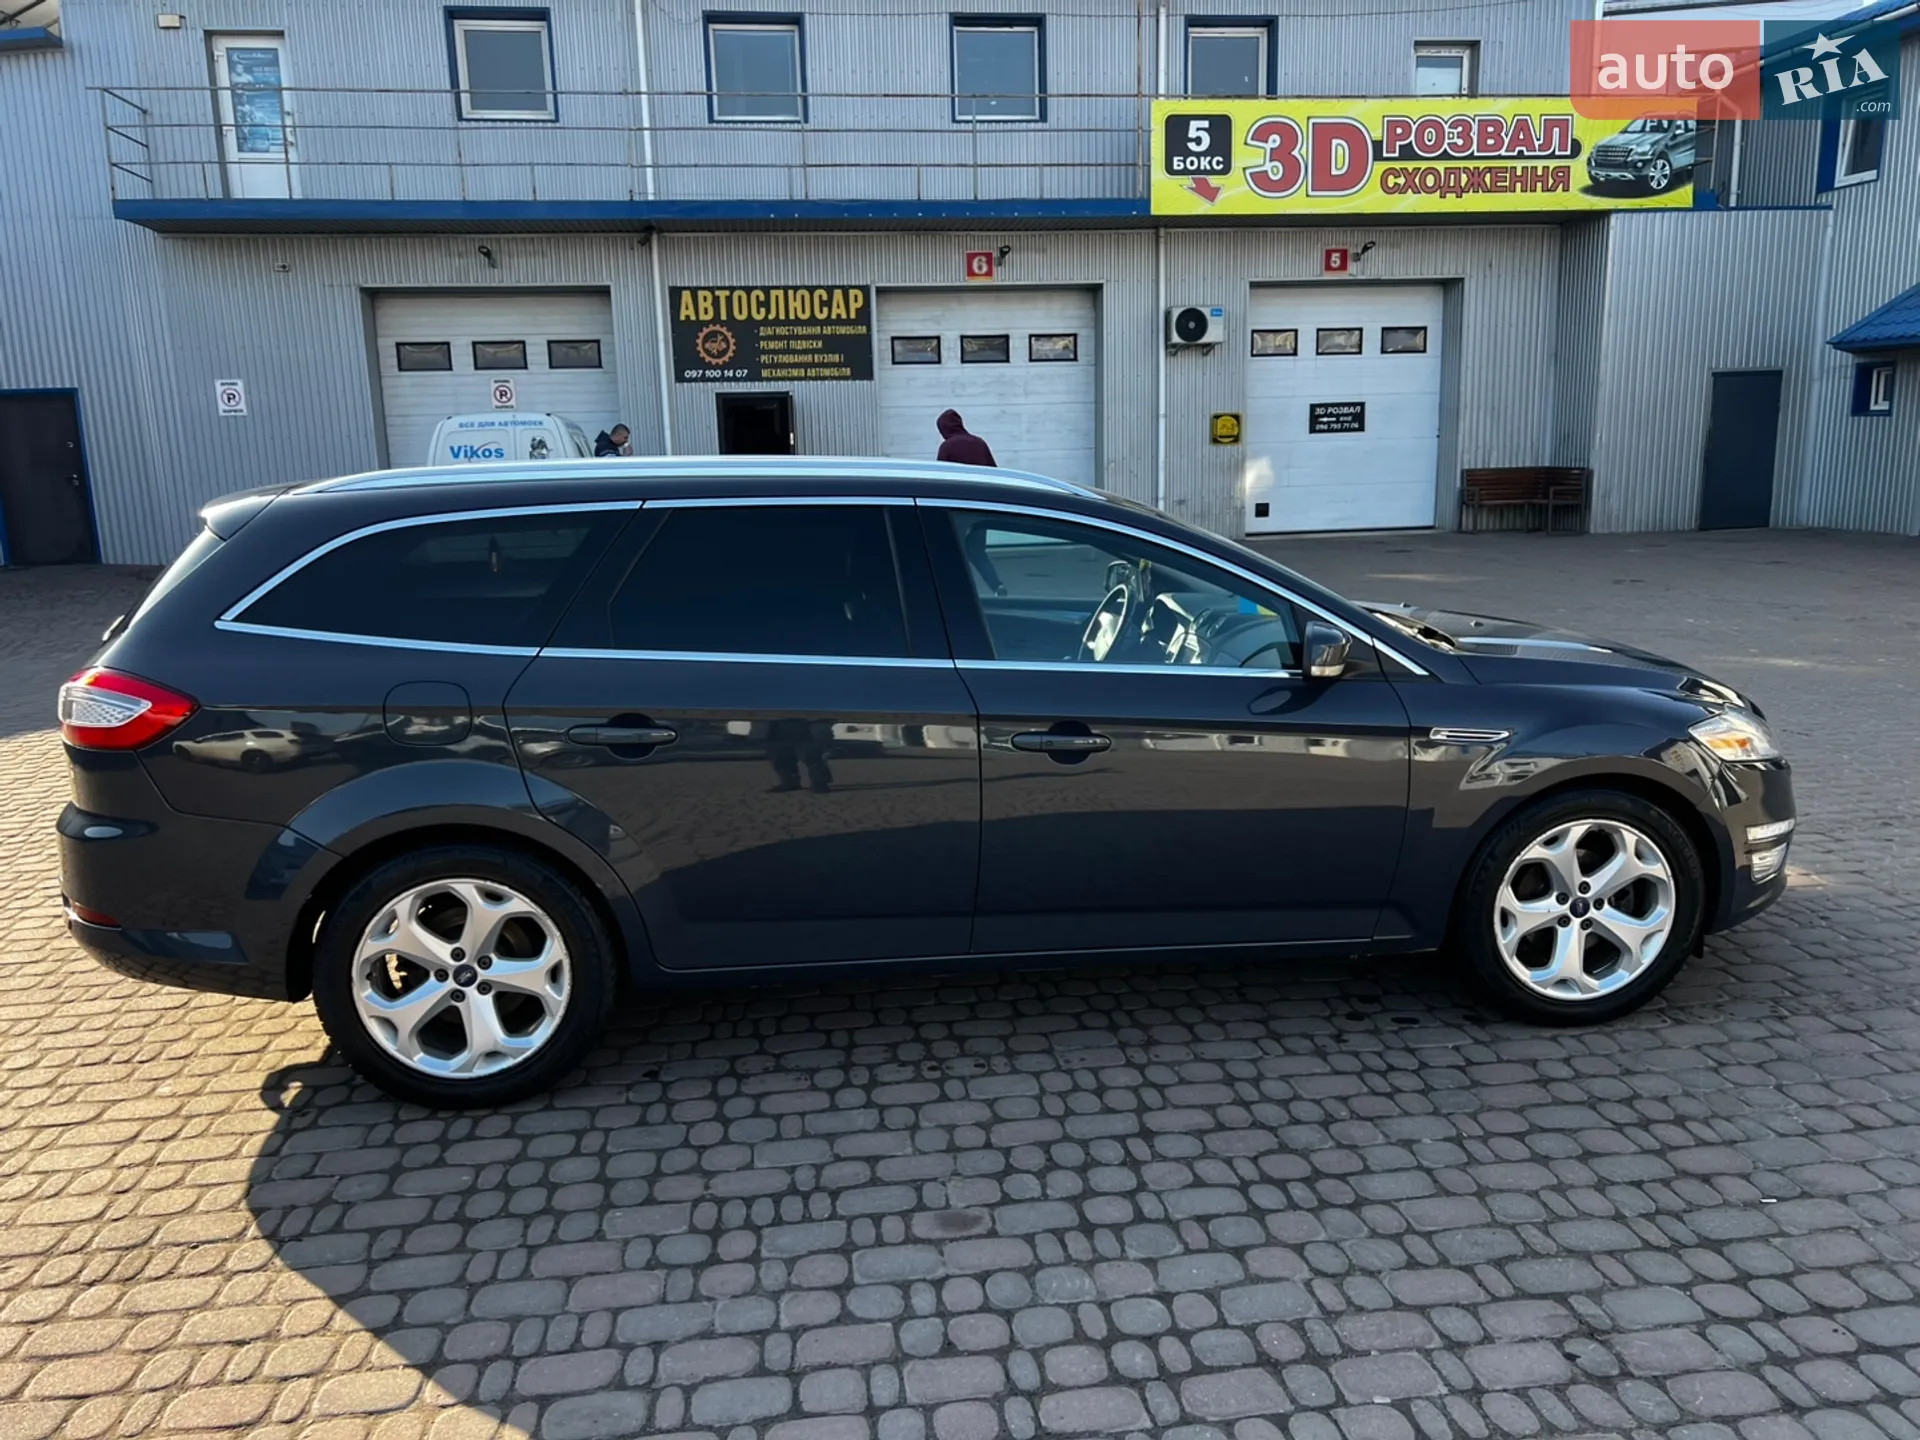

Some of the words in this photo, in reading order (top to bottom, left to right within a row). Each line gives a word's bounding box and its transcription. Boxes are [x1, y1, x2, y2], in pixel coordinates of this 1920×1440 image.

[1186, 120, 1211, 153] 5
[1382, 114, 1574, 158] РОЗВАЛ
[1172, 156, 1225, 171] БОКС
[1243, 115, 1374, 199] 3D
[1380, 165, 1570, 198] СХОДЖЕННЯ
[972, 254, 989, 275] 6
[1330, 252, 1341, 268] 5
[679, 288, 864, 321] АВТОСЛЮСАР
[760, 340, 788, 350] РЕМОНТ
[760, 354, 813, 363] РЕГУЛЮВАННЯ
[684, 369, 703, 378] 097
[705, 369, 721, 378] 100
[723, 369, 733, 377] 14
[735, 368, 748, 377] 07
[449, 445, 504, 459] Vikos
